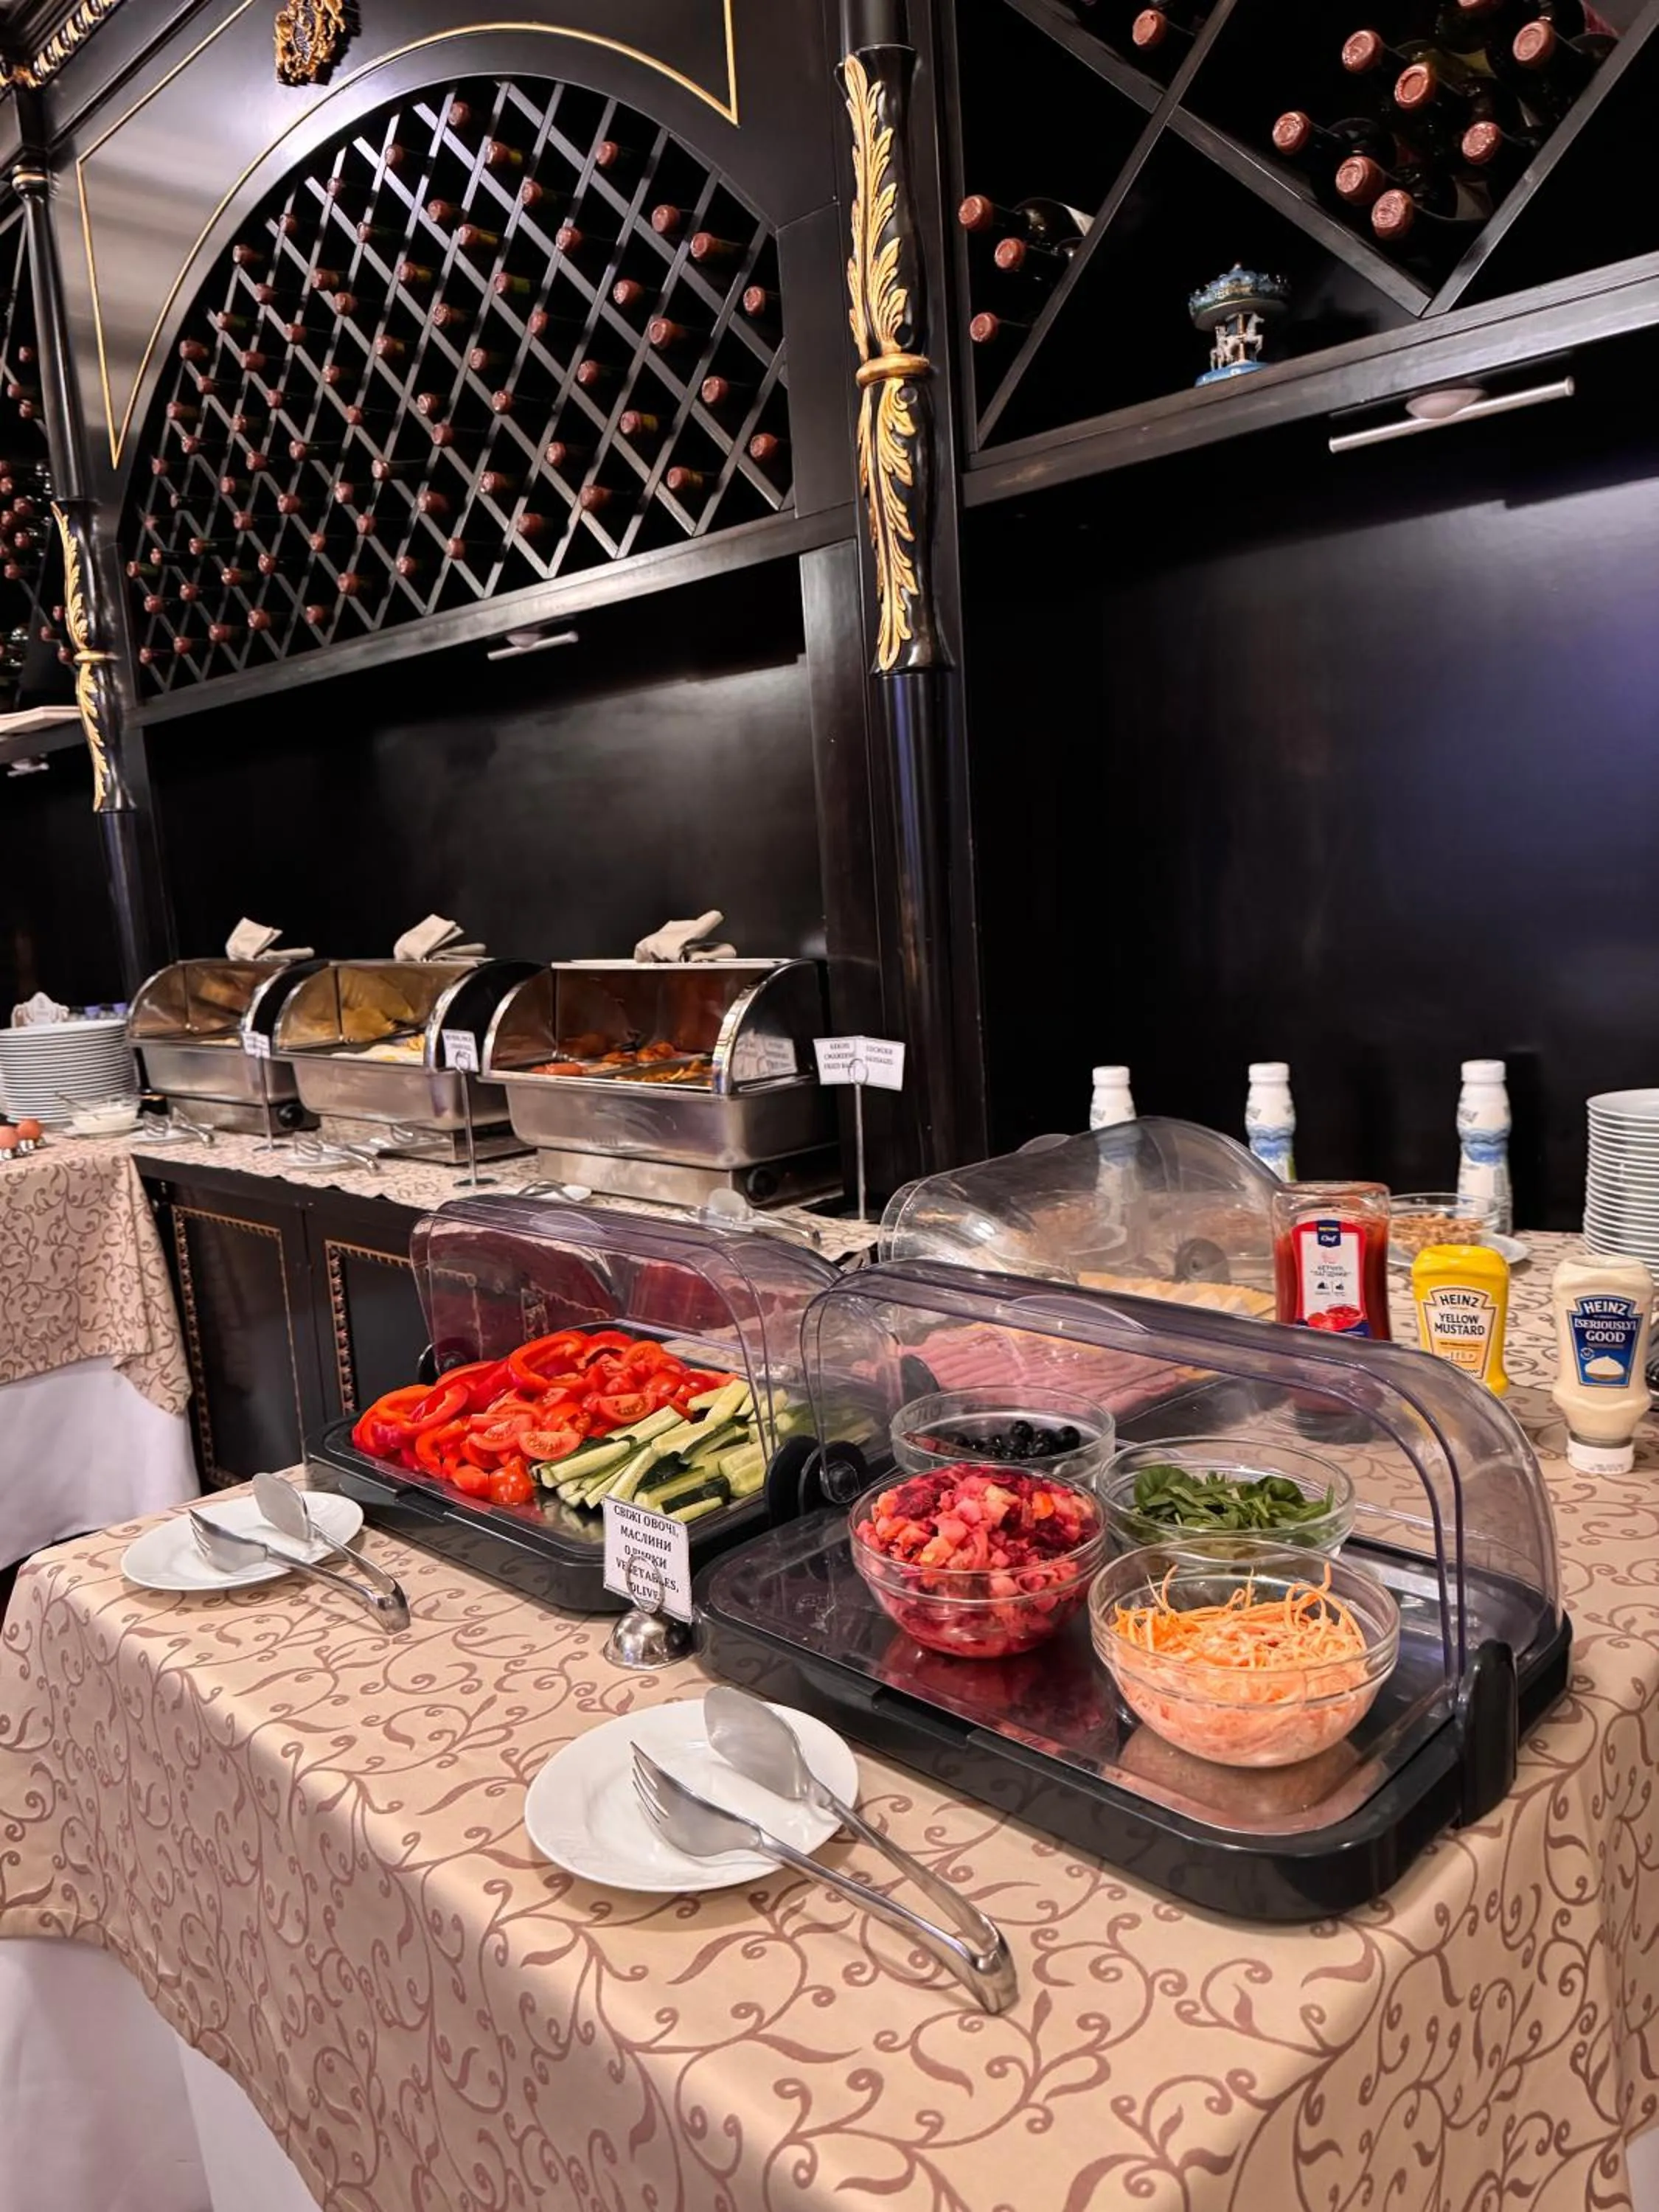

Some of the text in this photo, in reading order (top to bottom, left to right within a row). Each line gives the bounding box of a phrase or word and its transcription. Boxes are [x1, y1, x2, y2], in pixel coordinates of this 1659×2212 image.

[1439, 1294, 1479, 1308] HEINZ
[1583, 1300, 1628, 1316] HEINZ
[1439, 1312, 1480, 1324] YELLOW
[1434, 1322, 1485, 1335] MUSTARD
[1585, 1329, 1626, 1343] GOOD
[620, 1525, 672, 1552] МАСЛИНИ
[616, 1557, 679, 1593] VEETABES,
